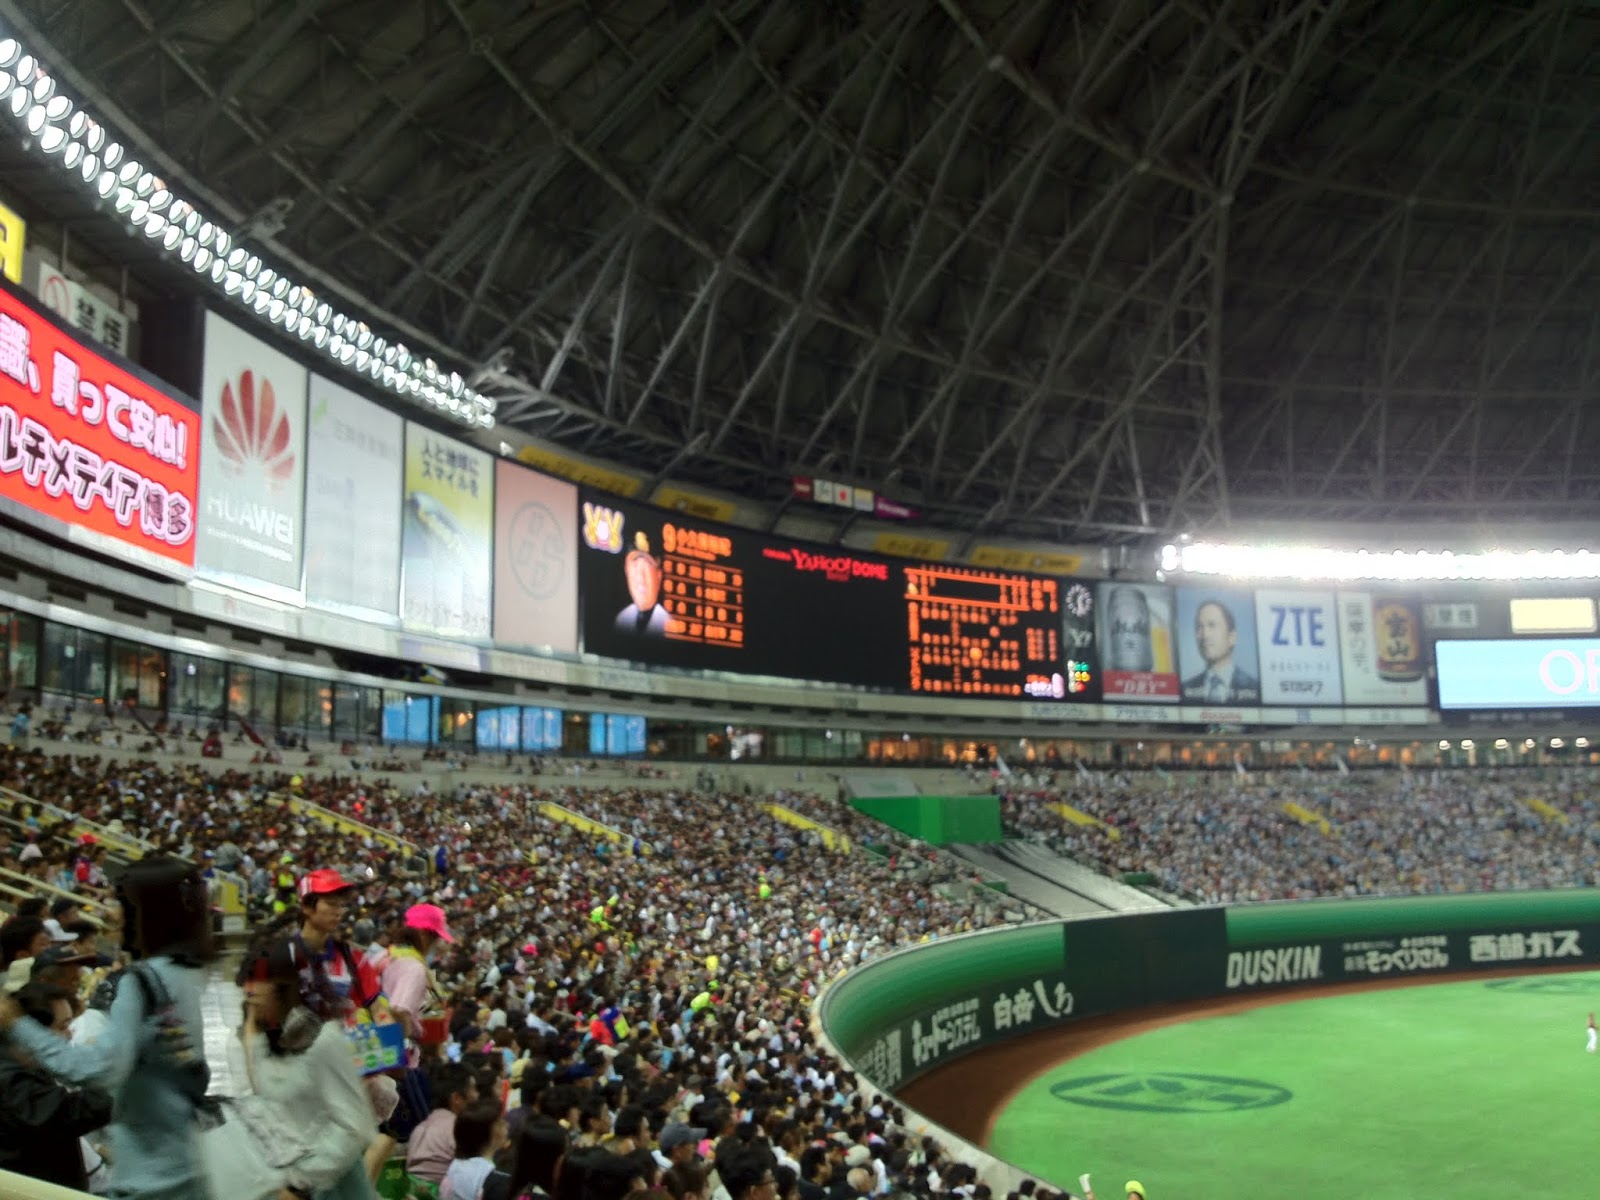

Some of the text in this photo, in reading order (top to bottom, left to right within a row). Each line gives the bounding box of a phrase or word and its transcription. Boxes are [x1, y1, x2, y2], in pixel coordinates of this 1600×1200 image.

[207, 496, 294, 545] HUAWEI
[1270, 606, 1325, 647] ZTE
[1225, 945, 1322, 989] DUSKIN
